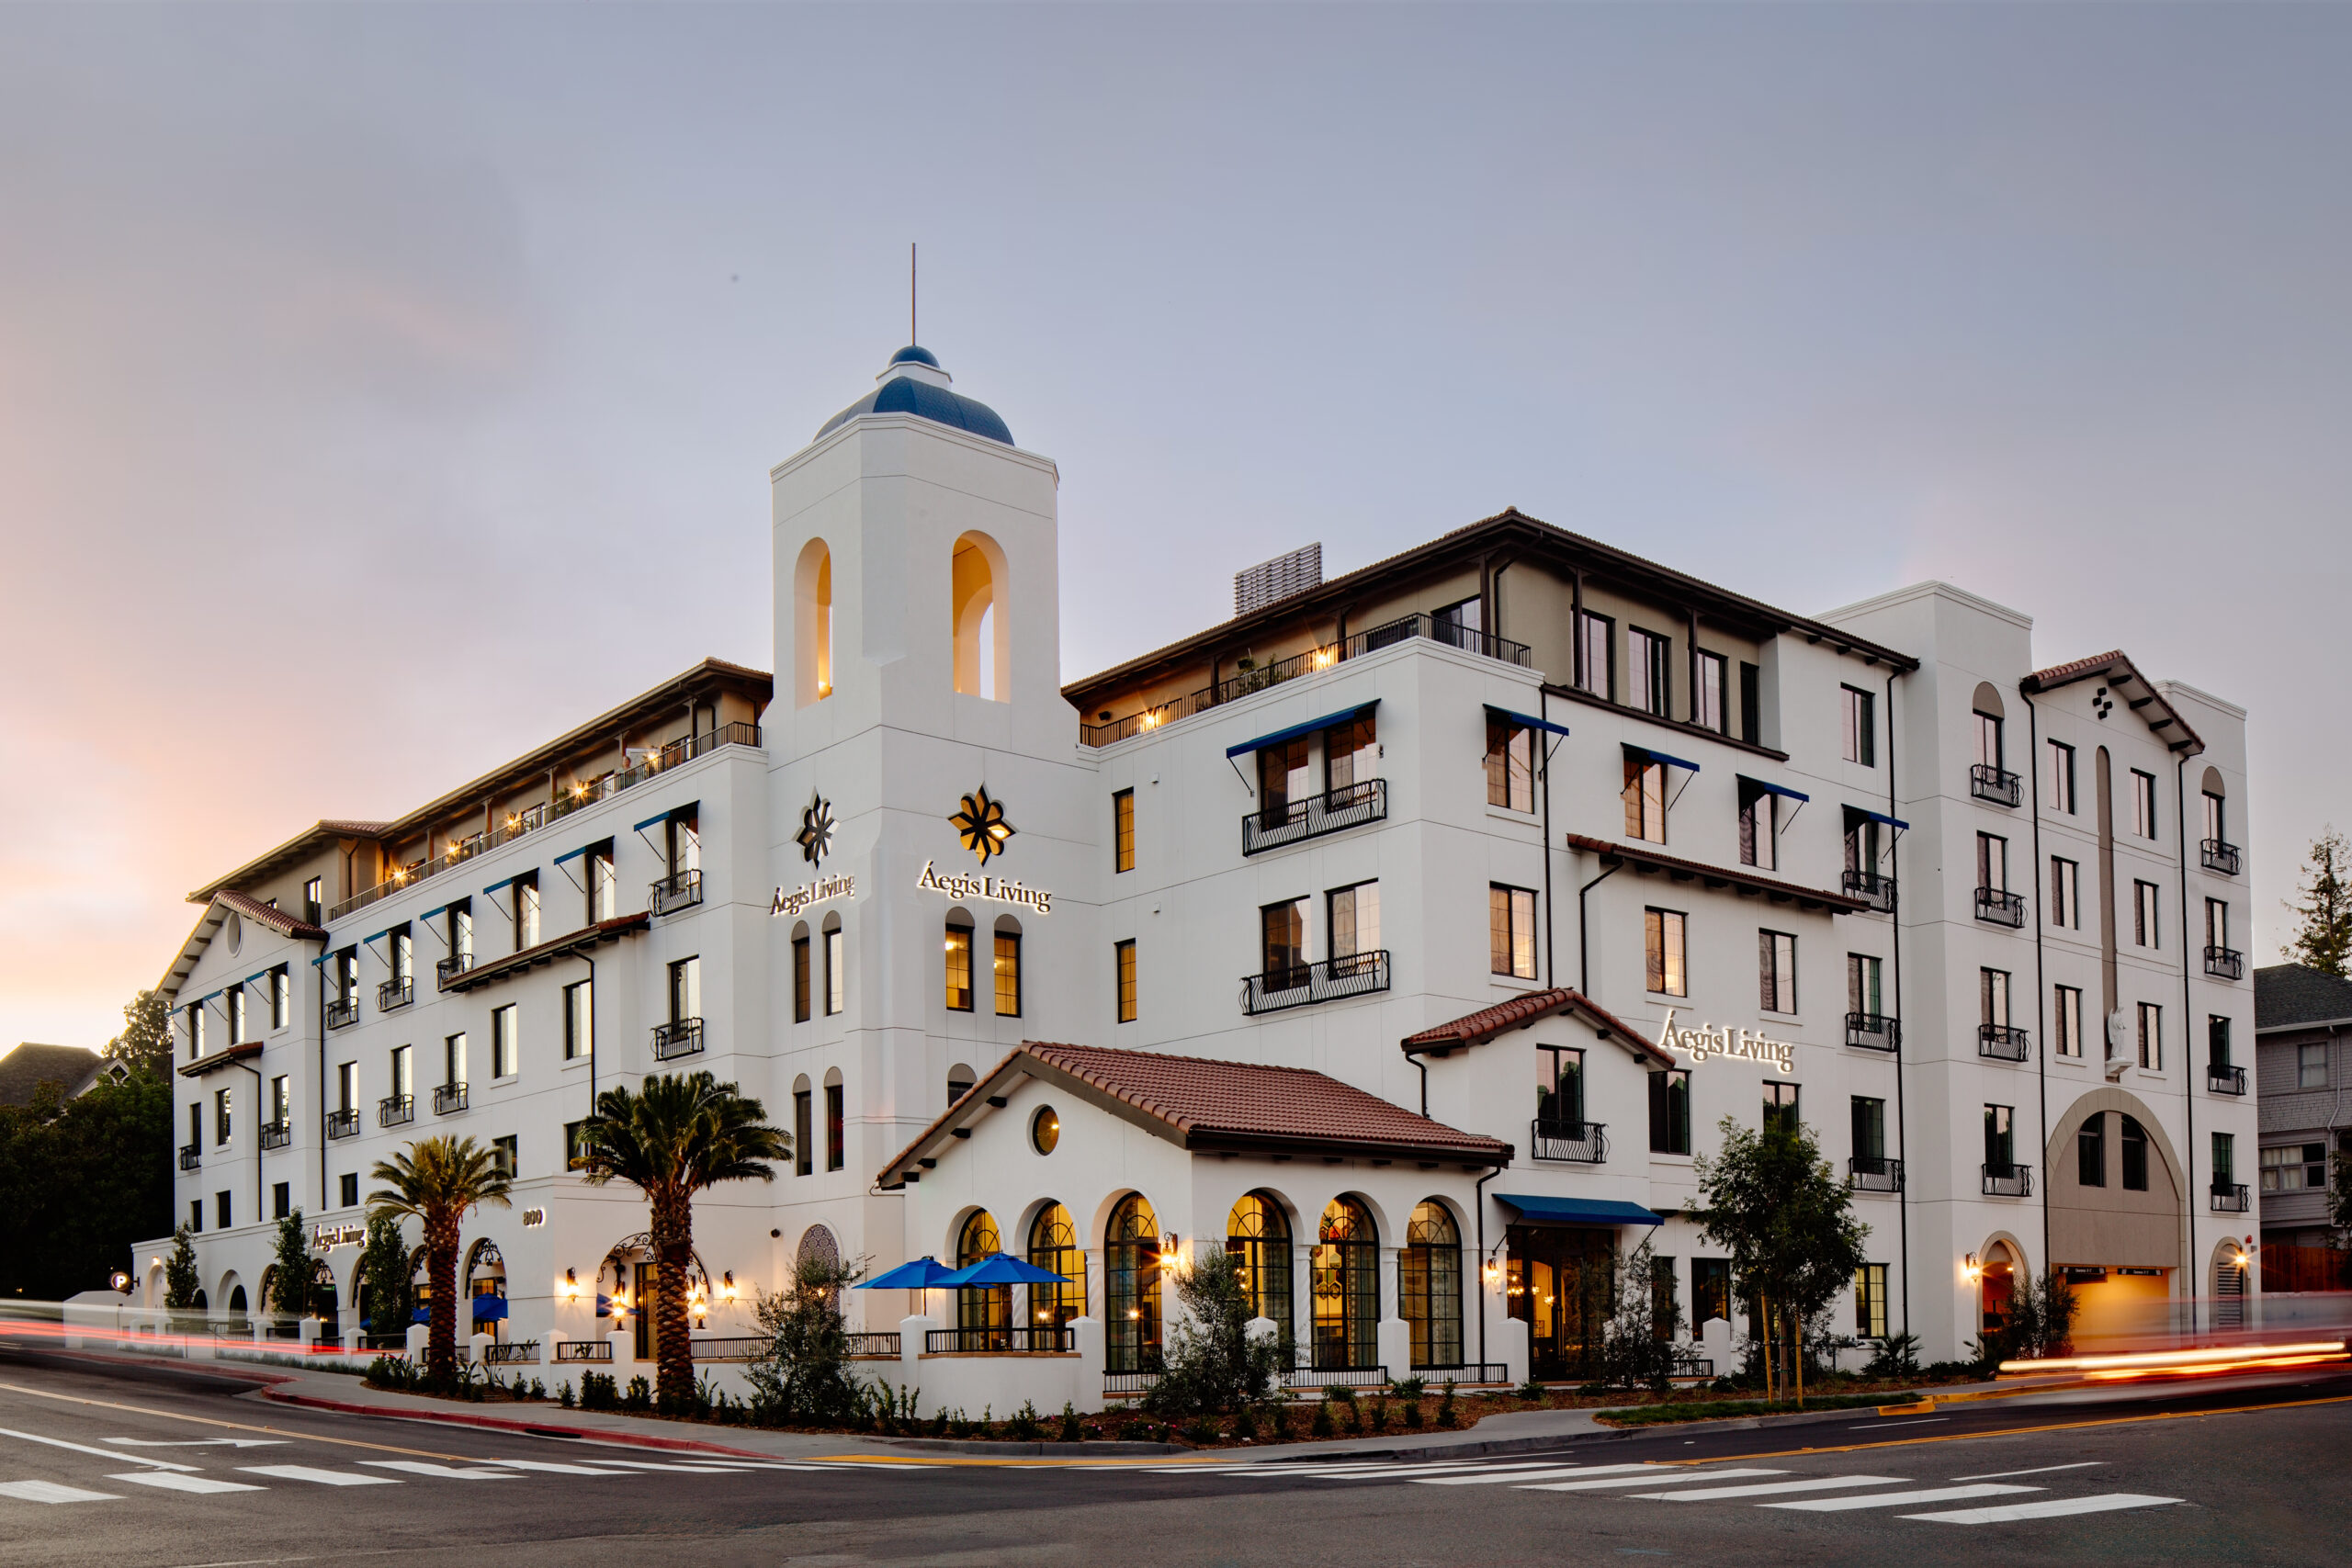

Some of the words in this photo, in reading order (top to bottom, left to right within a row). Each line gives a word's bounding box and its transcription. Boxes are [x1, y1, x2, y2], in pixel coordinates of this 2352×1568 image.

[809, 874, 854, 902] Living
[982, 877, 1051, 913] Living
[1724, 1029, 1795, 1072] Living
[523, 1209, 544, 1226] 800
[116, 1275, 128, 1288] P
